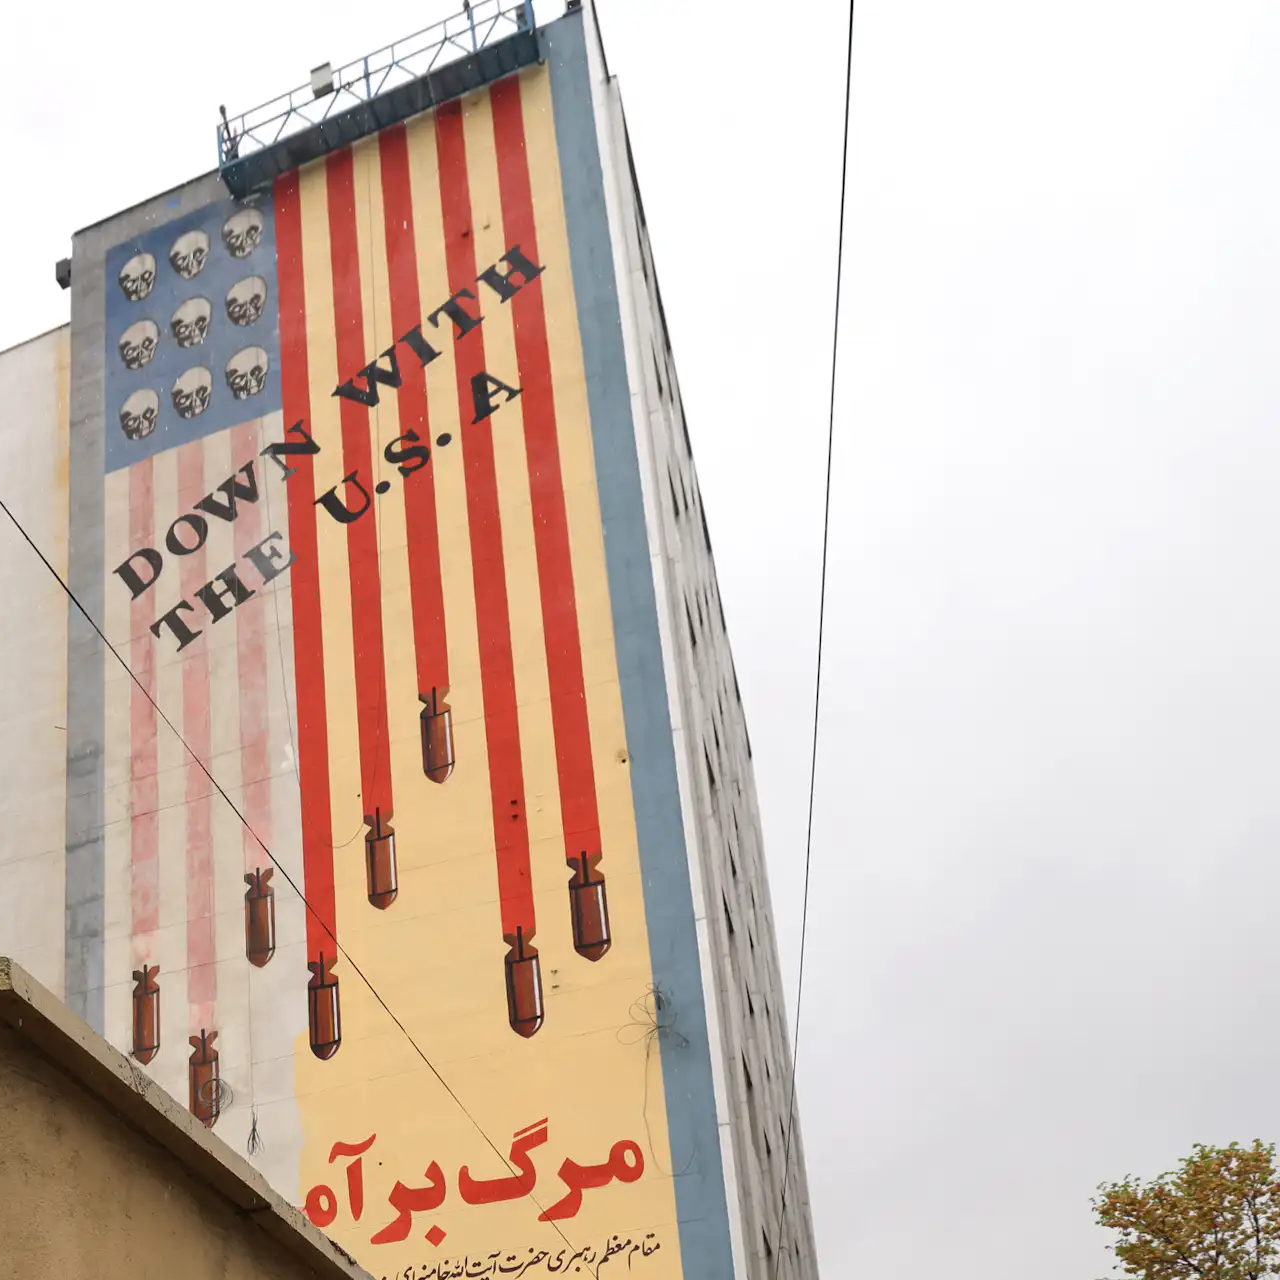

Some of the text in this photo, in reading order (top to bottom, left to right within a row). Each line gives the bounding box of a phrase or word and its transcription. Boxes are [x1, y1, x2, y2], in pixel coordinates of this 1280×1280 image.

[113, 244, 546, 601] DOWN WITH
[150, 531, 297, 652] THE
[302, 1117, 645, 1247] مرگ بر آم
[498, 1247, 551, 1280] حضرت
[547, 1244, 597, 1274] رهبری
[628, 1233, 661, 1271] مقام
